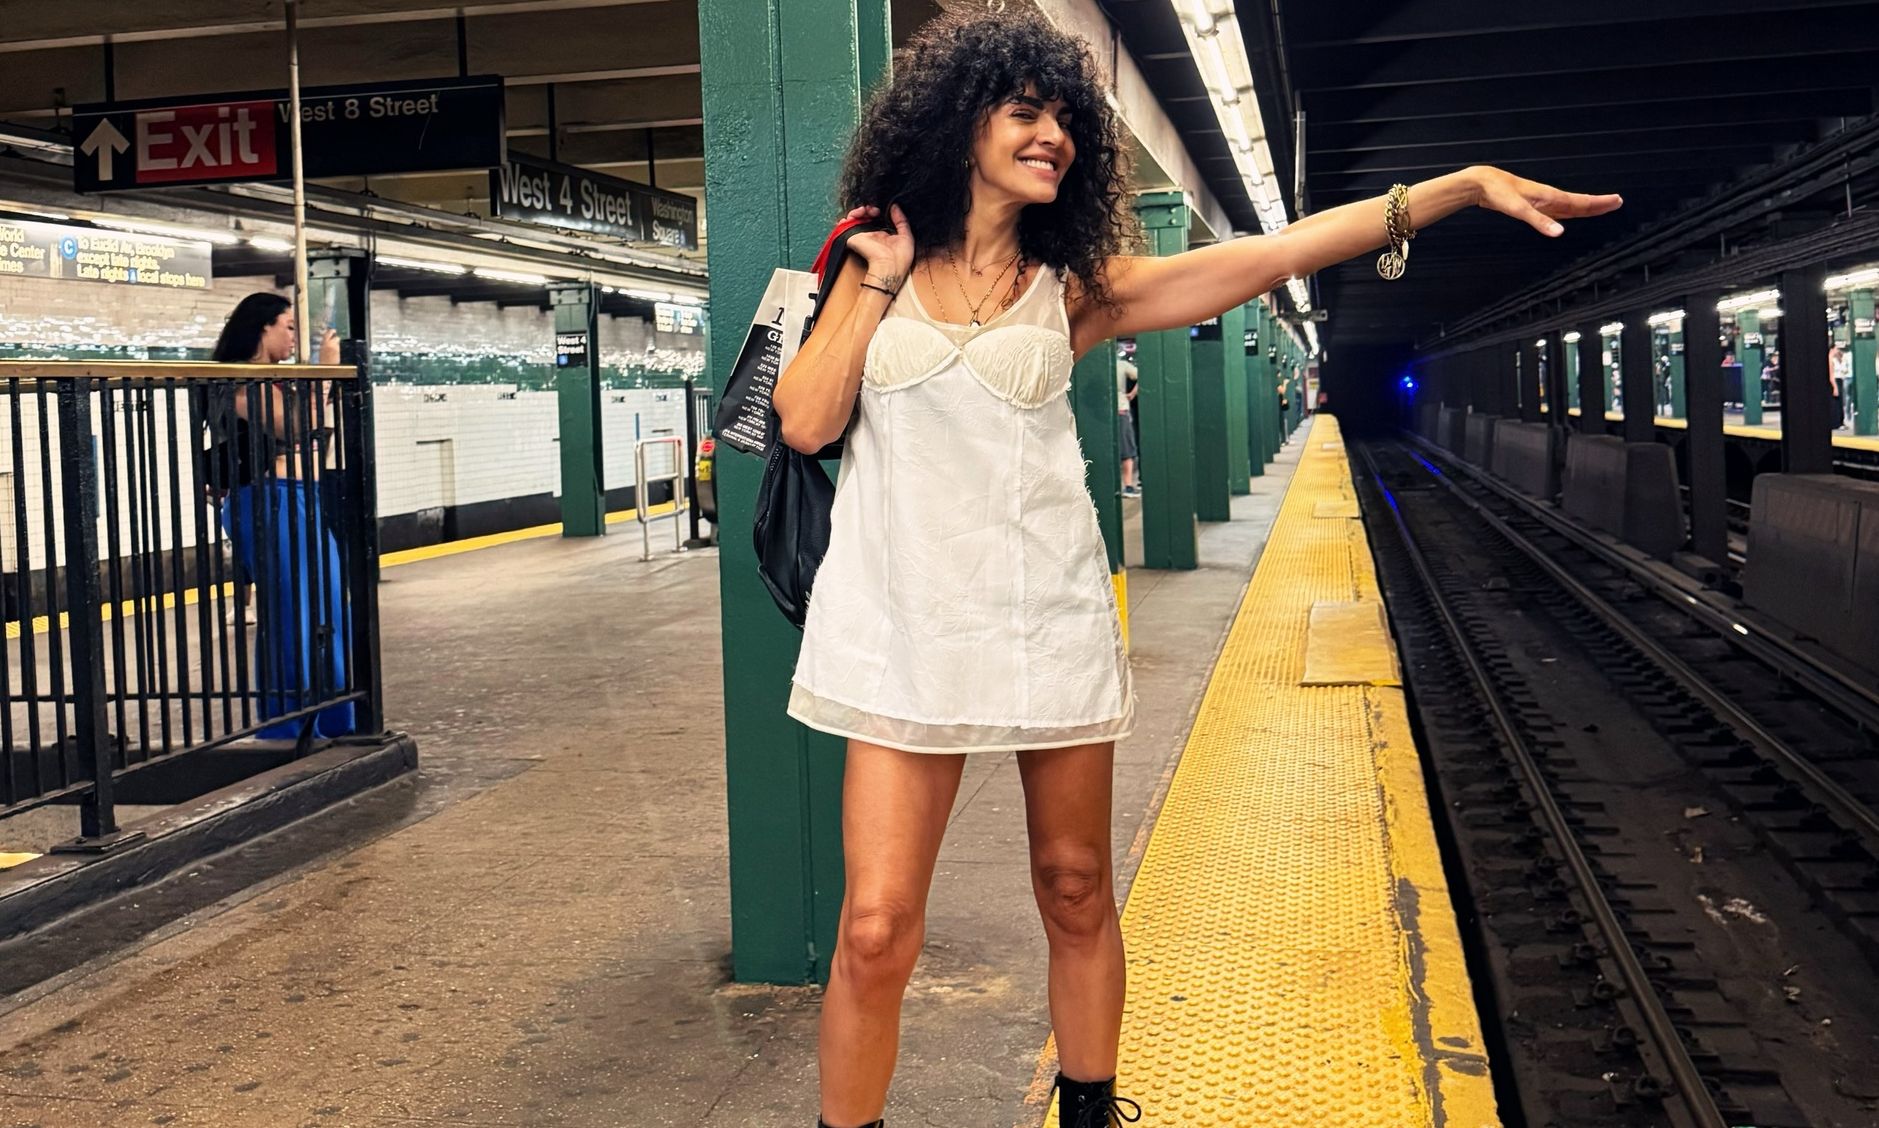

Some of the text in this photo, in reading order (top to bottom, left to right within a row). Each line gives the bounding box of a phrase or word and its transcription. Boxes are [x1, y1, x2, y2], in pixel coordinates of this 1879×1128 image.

[344, 99, 360, 119] 8
[369, 93, 439, 118] Street
[136, 106, 260, 172] Exit
[499, 161, 633, 226] West 4 Street
[651, 197, 694, 225] Washington
[652, 220, 680, 244] Square
[10, 242, 45, 259] Center
[77, 251, 109, 267] except
[136, 242, 175, 260] Brooklyn
[77, 264, 99, 279] Late
